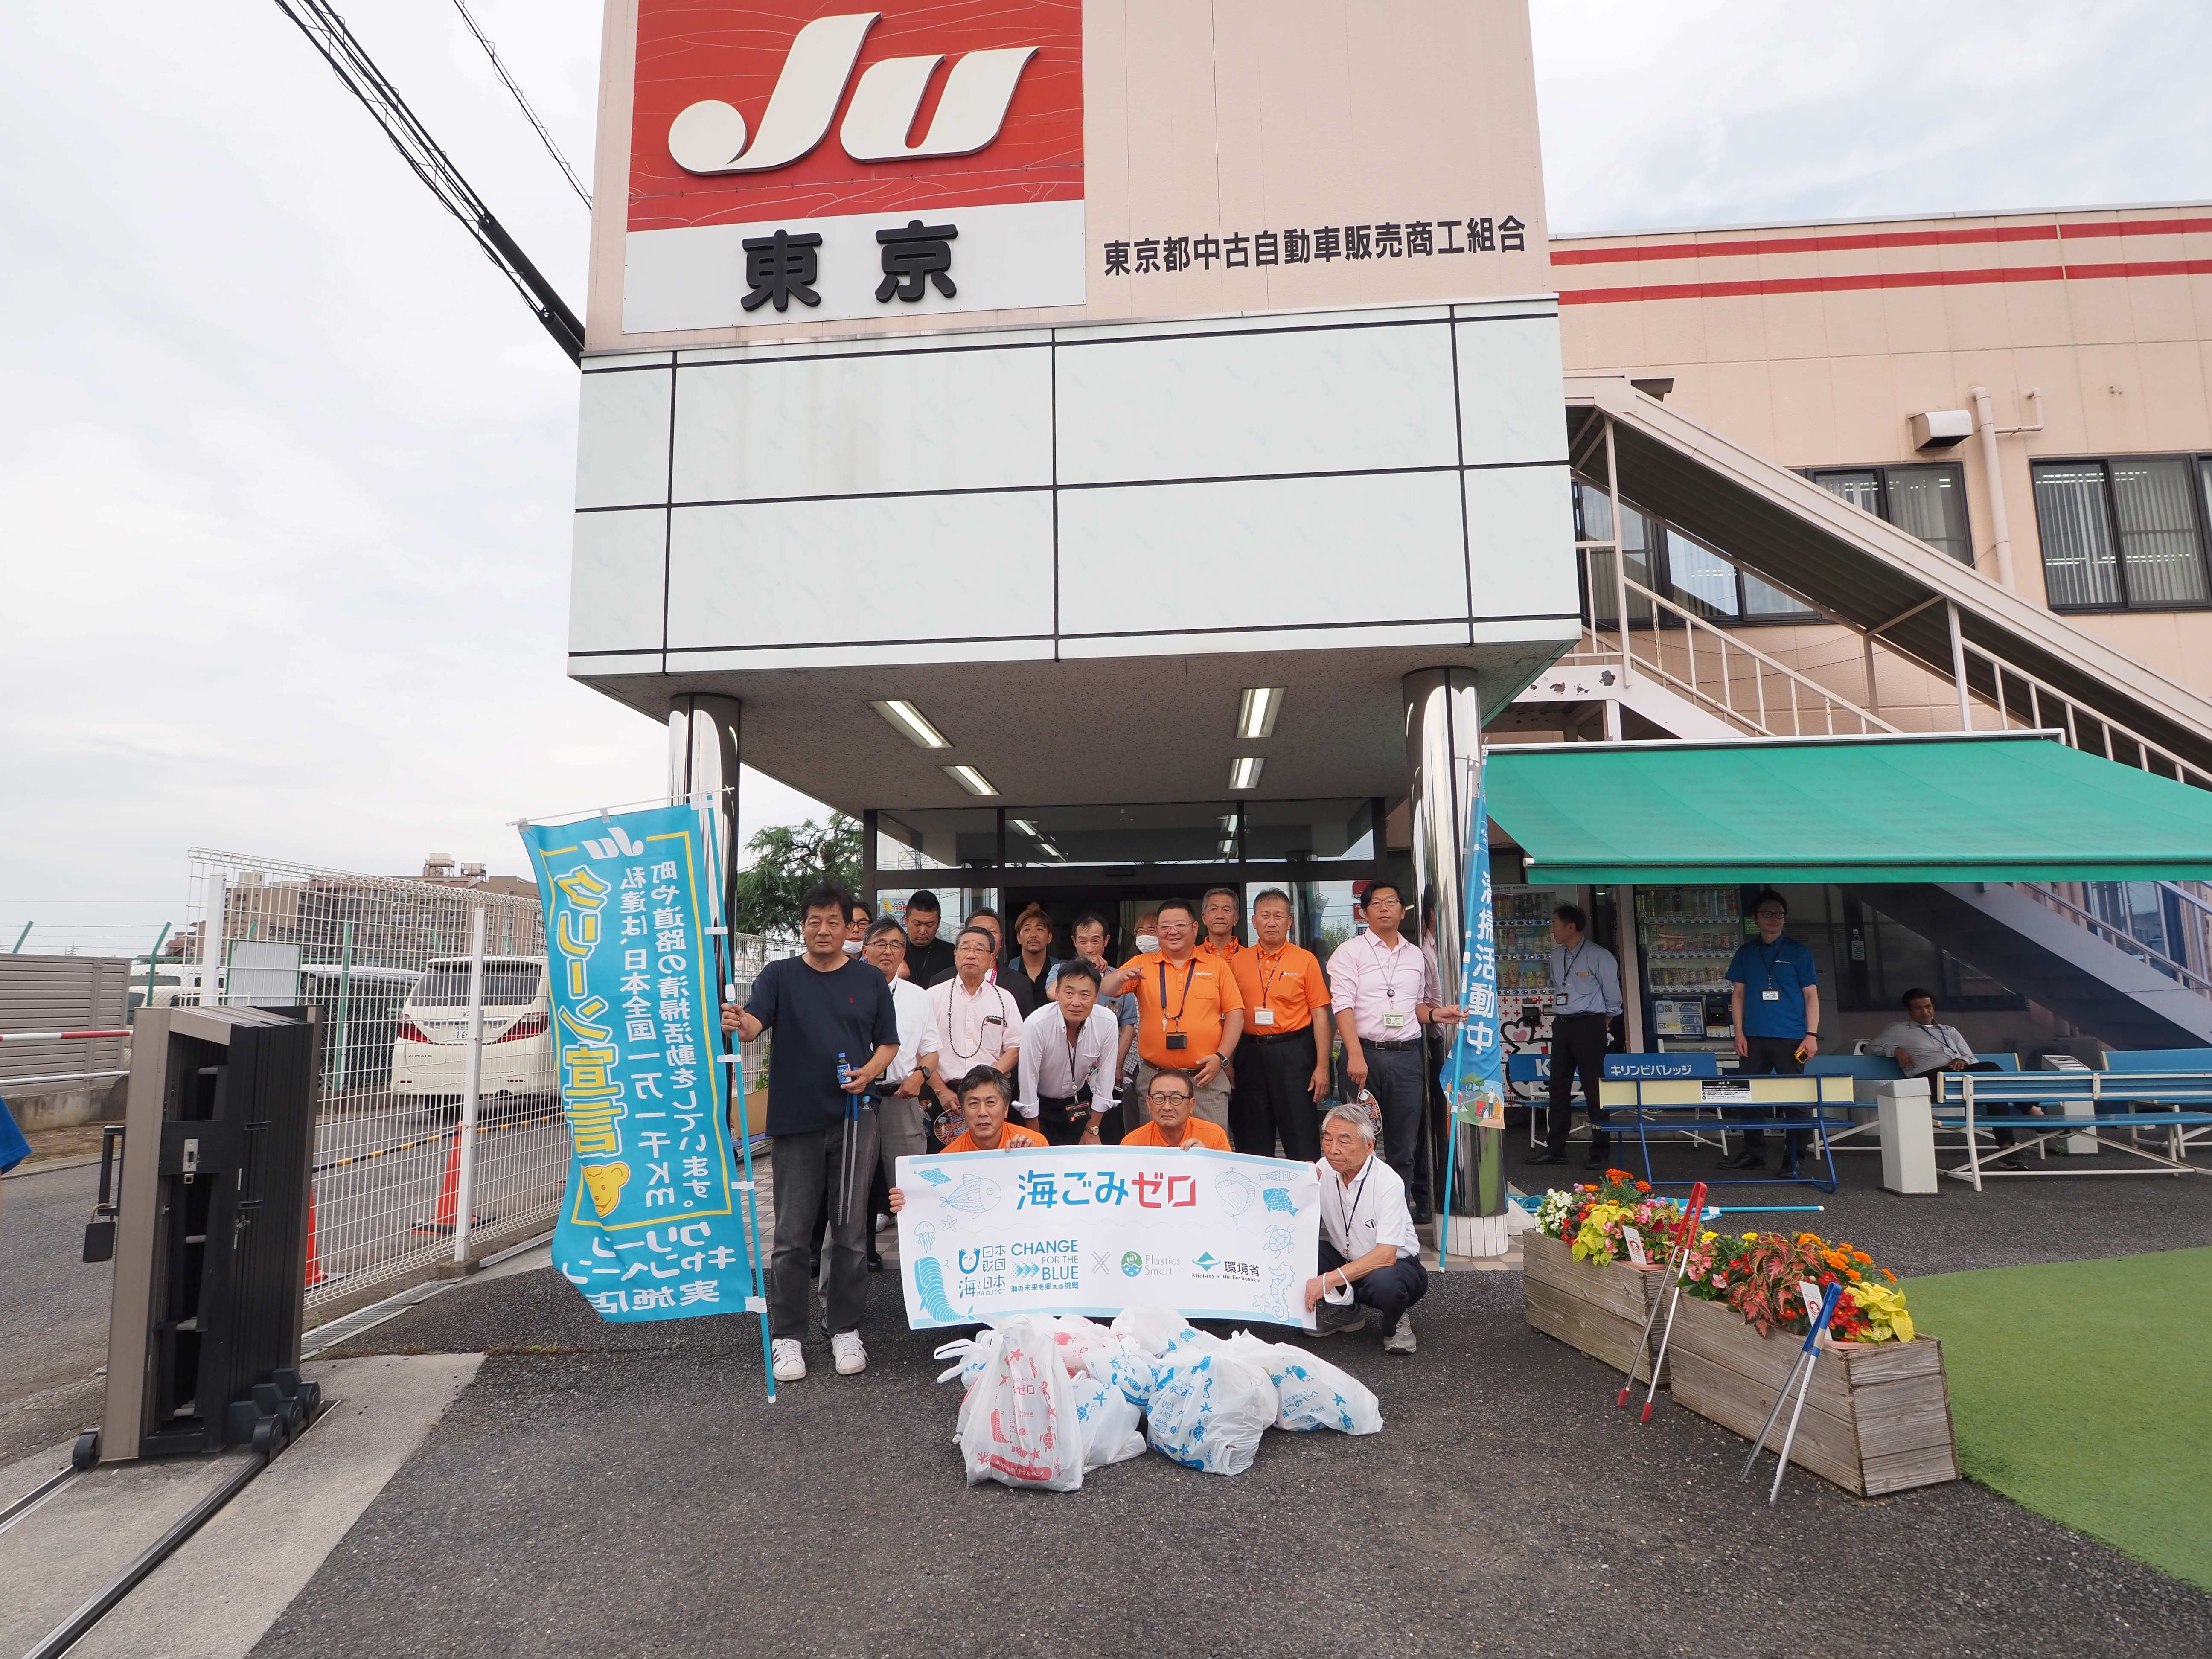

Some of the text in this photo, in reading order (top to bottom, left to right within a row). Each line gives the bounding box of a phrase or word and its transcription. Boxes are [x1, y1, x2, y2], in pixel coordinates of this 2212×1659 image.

[1103, 215, 1526, 276] 東京都中古自動車販売商工組合
[740, 219, 958, 312] 東京
[1610, 1064, 1692, 1076] キリンビバレッジ
[1016, 1169, 1196, 1210] 海ごみゼロ
[1011, 1239, 1079, 1256] CHANGE
[1042, 1255, 1079, 1264] FOR THE
[1145, 1255, 1180, 1266] Plastics
[1042, 1266, 1079, 1281] BLUE
[1145, 1265, 1173, 1276] Smart
[1223, 1261, 1260, 1277] 環境省
[1232, 1275, 1261, 1283] Environment
[1011, 1281, 1079, 1293] 海の未来を変える挑戦
